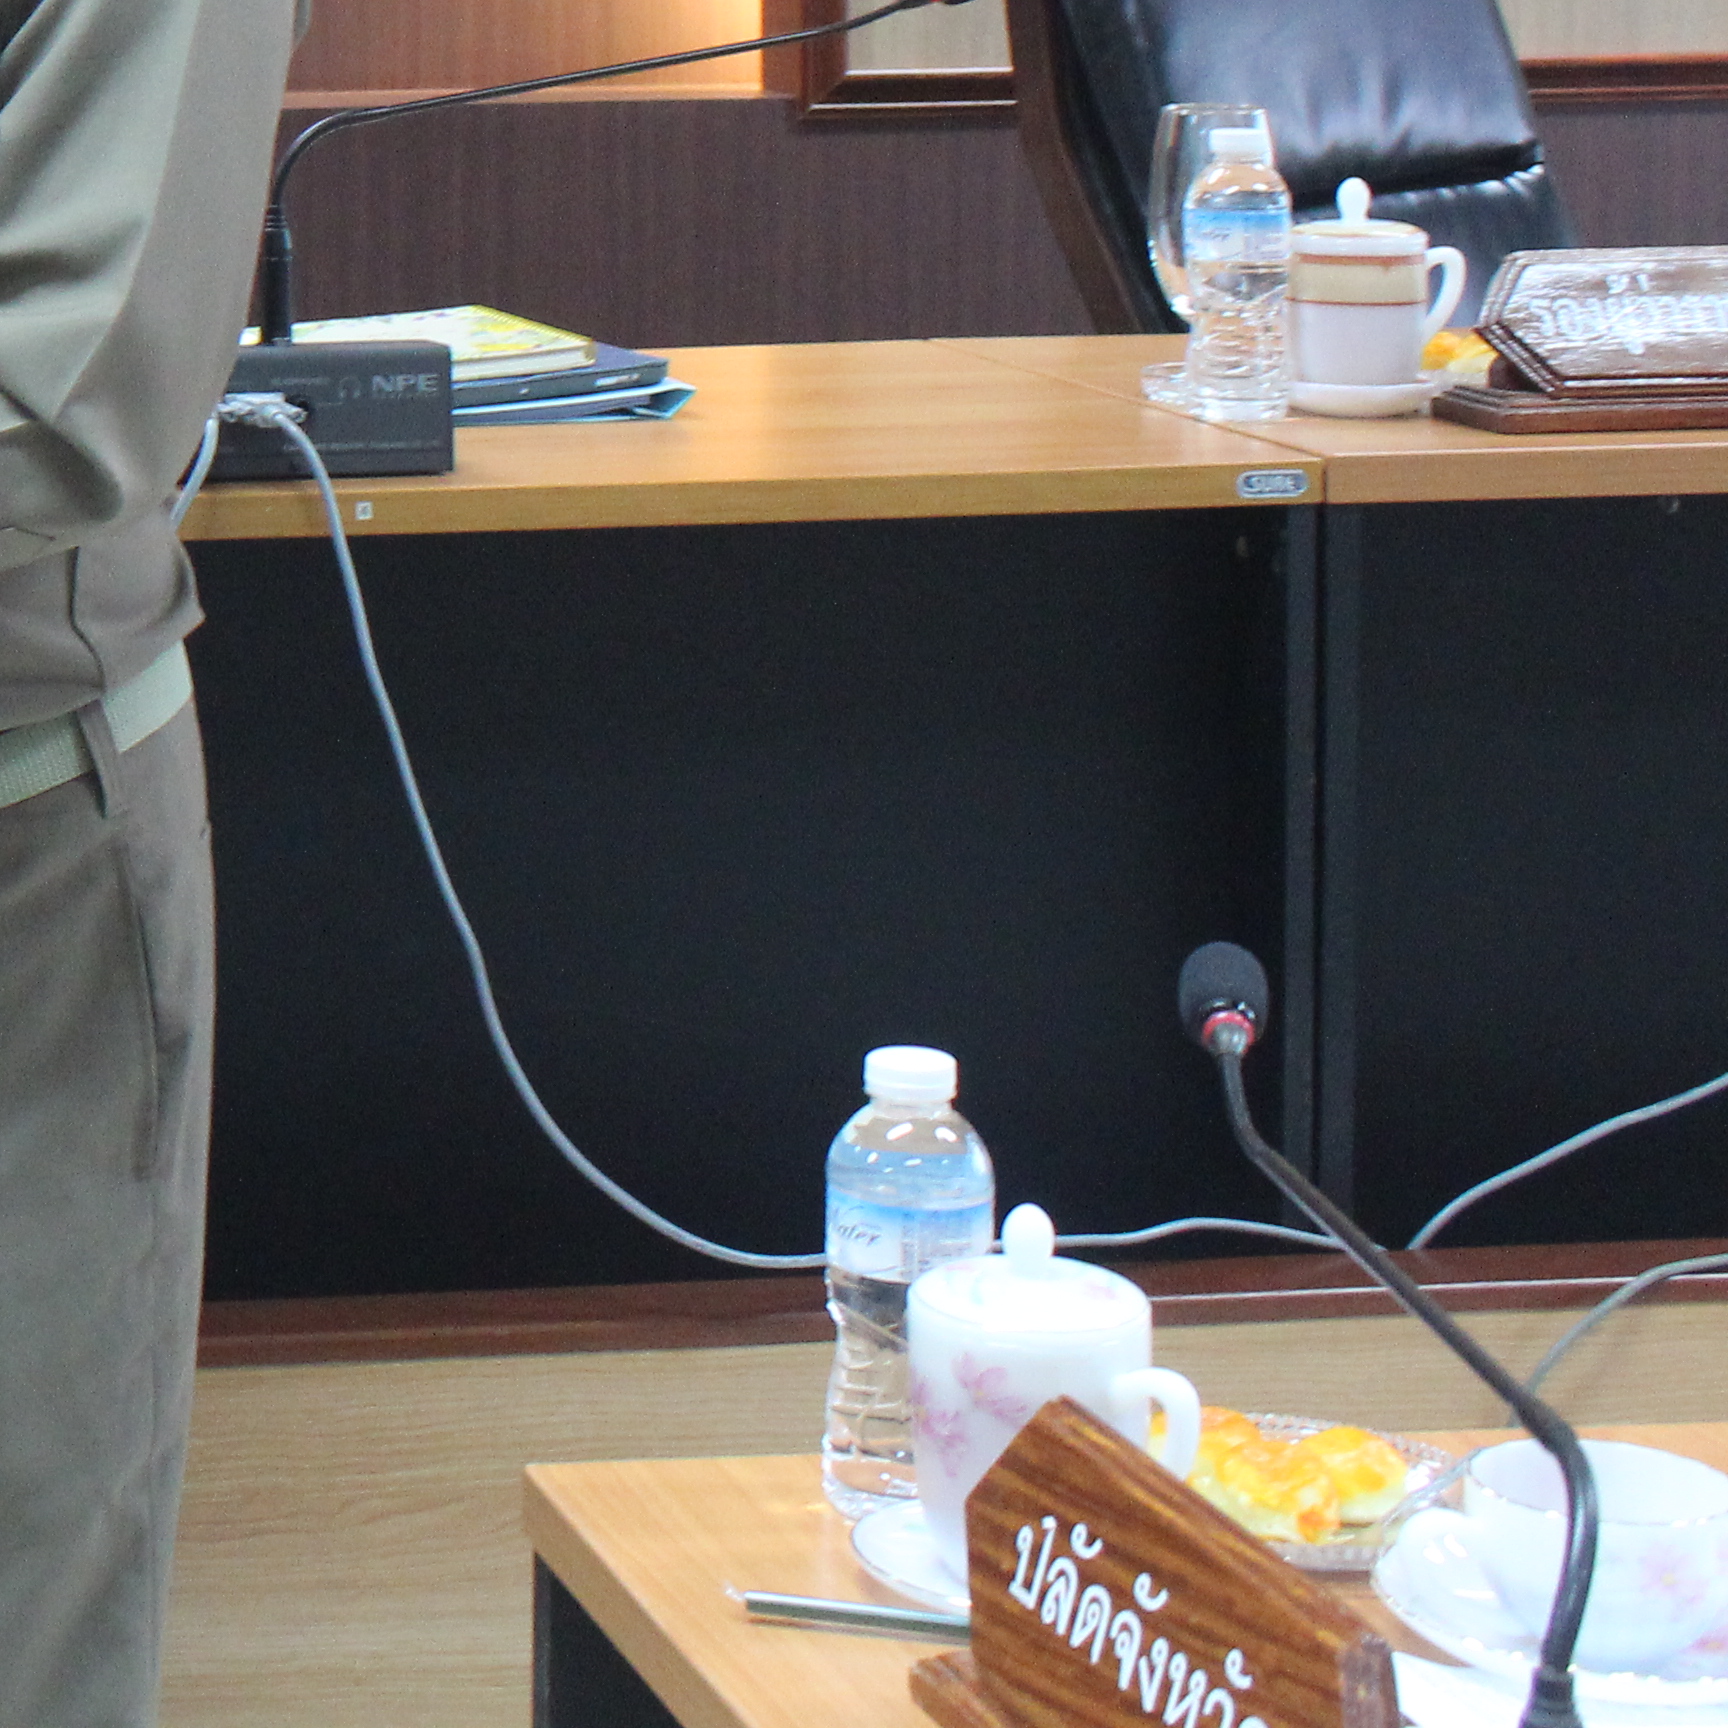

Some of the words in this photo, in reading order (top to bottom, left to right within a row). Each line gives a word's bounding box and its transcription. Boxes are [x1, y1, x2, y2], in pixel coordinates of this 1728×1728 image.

[371, 374, 440, 393] NPE
[1007, 1515, 1270, 1728] ปลัดจังหวั
